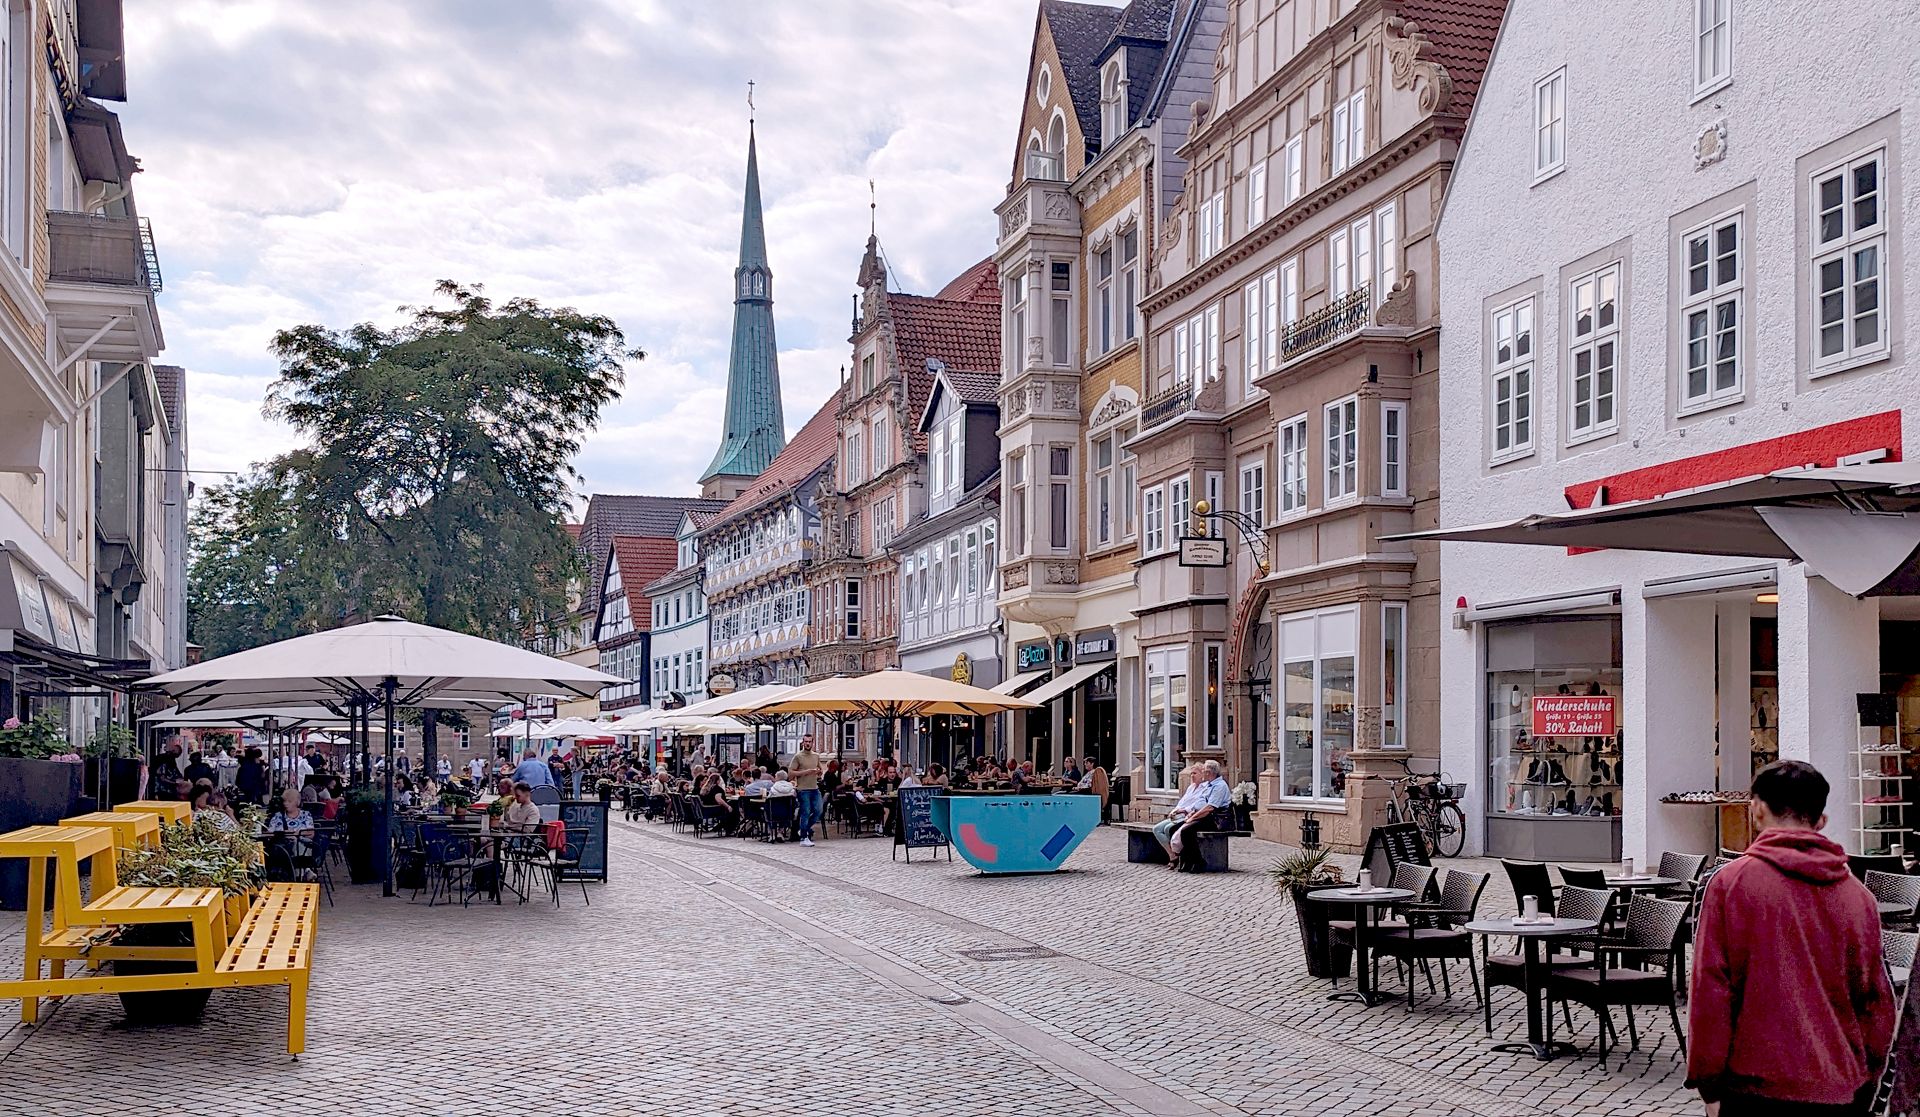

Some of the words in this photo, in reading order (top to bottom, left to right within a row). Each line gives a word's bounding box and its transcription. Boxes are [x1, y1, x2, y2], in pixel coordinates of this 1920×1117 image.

[1018, 645, 1045, 667] LaPlaza
[1536, 699, 1612, 712] Kinderschuhe
[1545, 713, 1561, 721] Größe
[1576, 713, 1592, 721] Größe
[1545, 722, 1566, 733] 30%
[1568, 721, 1603, 733] Rabatt
[564, 805, 596, 823] STOP
